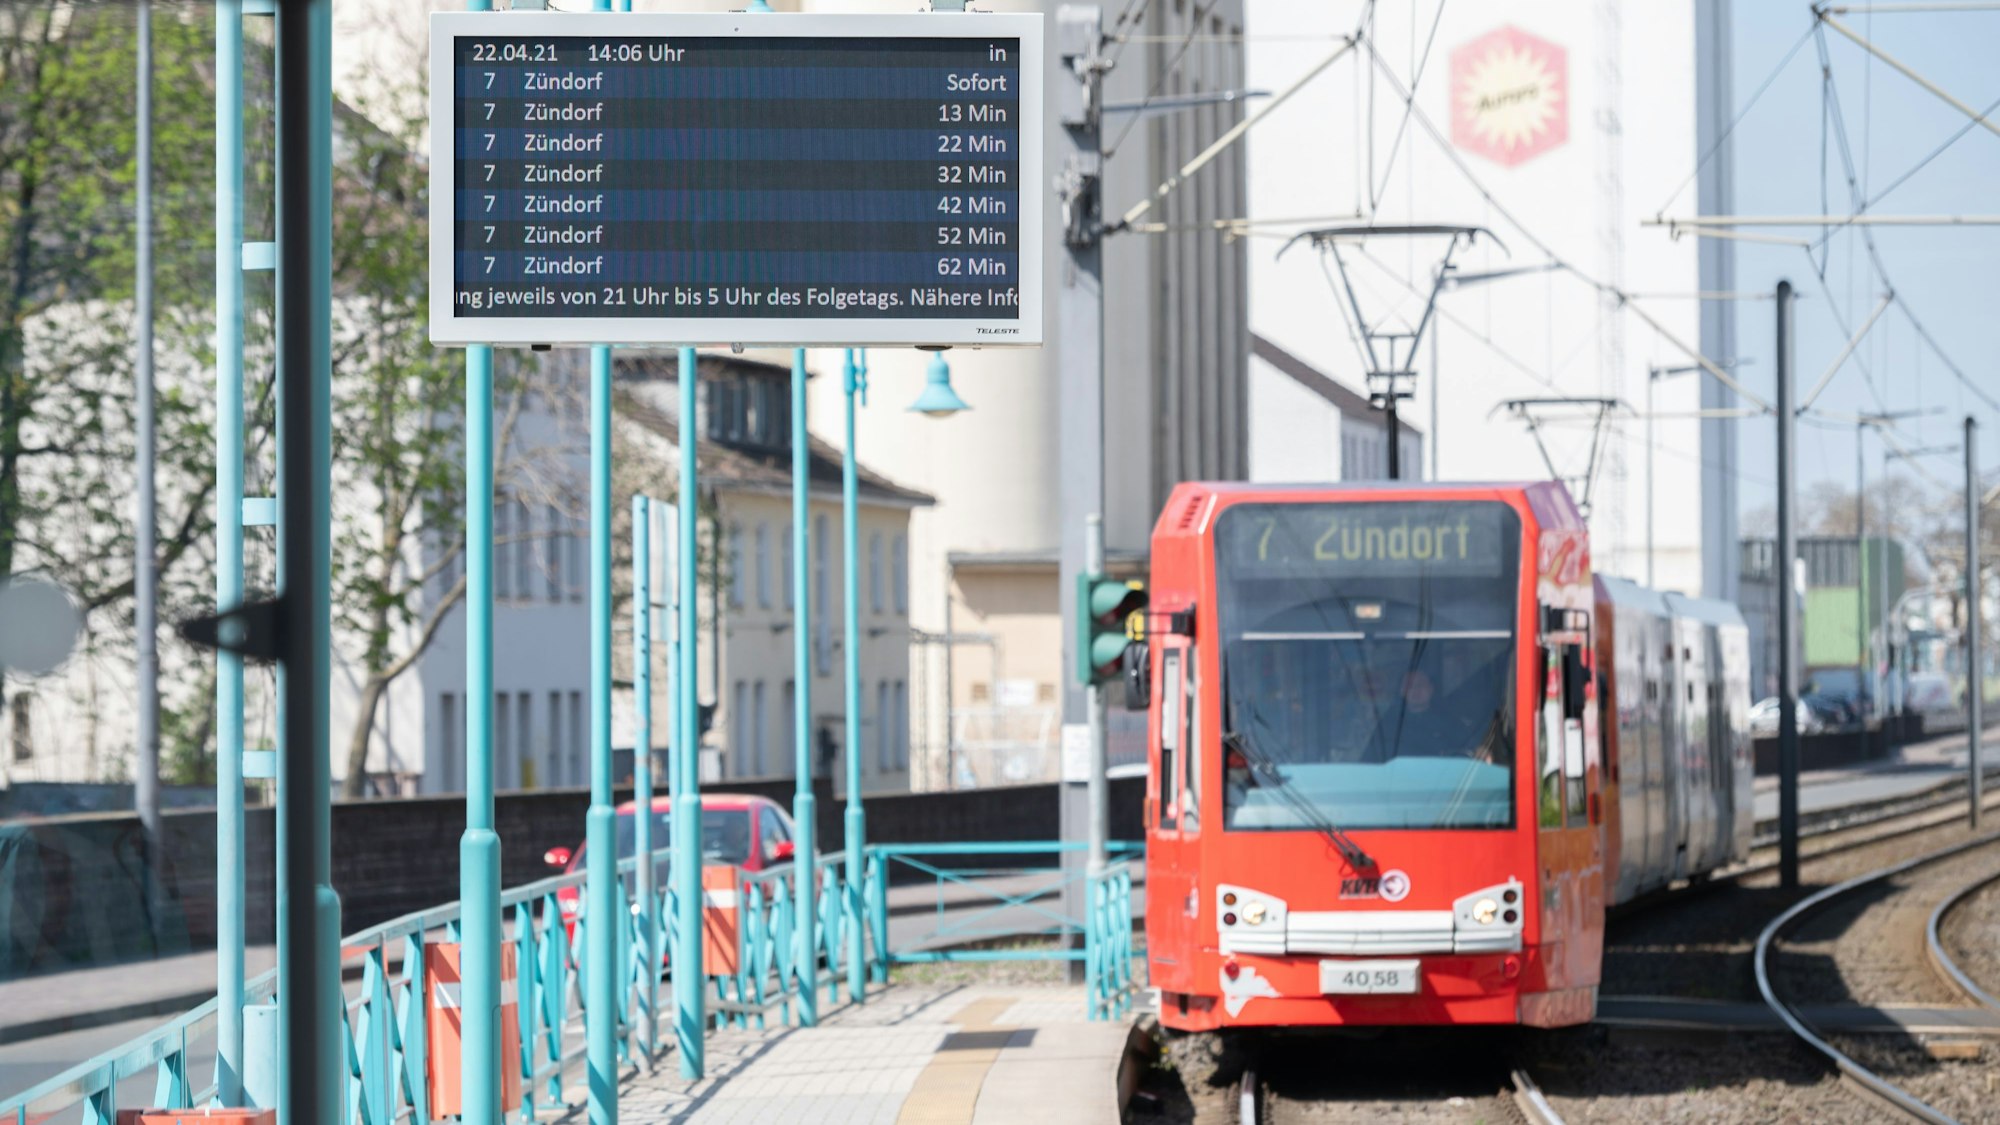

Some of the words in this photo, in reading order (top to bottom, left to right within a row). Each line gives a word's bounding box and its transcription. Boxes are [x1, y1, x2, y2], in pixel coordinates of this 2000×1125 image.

[472, 44, 558, 62] 22.04.21
[588, 44, 643, 62] 14:06
[648, 44, 685, 62] Uhr
[989, 44, 1007, 62] in
[484, 72, 496, 90] 7
[523, 72, 604, 90] Zündorf
[946, 72, 1007, 92] Sofort
[484, 102, 496, 121] 7
[523, 102, 604, 121] Zündorf
[939, 103, 962, 122] 13
[968, 103, 1007, 122] Min
[484, 133, 496, 152] 7
[523, 133, 604, 152] Zündorf
[937, 134, 962, 153] 22
[968, 134, 1007, 153] Min
[484, 164, 496, 183] 7
[523, 164, 604, 183] Zündorf
[937, 165, 962, 184] 32
[968, 165, 1007, 184] Min
[484, 194, 496, 213] 7
[523, 194, 604, 213] Zündorf
[936, 195, 962, 214] 42
[968, 195, 1007, 214] Min
[484, 225, 496, 244] 7
[523, 225, 604, 244] Zündorf
[936, 226, 962, 245] 52
[968, 226, 1007, 245] Min
[484, 256, 496, 275] 7
[523, 256, 604, 275] Zündorf
[936, 257, 962, 276] 62
[968, 257, 1007, 276] Min
[455, 290, 483, 309] ng
[486, 286, 556, 309] jeweils
[560, 291, 597, 305] von
[603, 287, 626, 305] 21
[633, 286, 670, 305] Uhr
[674, 286, 702, 305] bis
[707, 287, 719, 305] 5
[725, 287, 762, 306] Uhr
[766, 286, 801, 306] des
[807, 287, 904, 310] Folgetags.
[911, 287, 982, 306] Nähere
[1313, 514, 1470, 560] Zündorf
